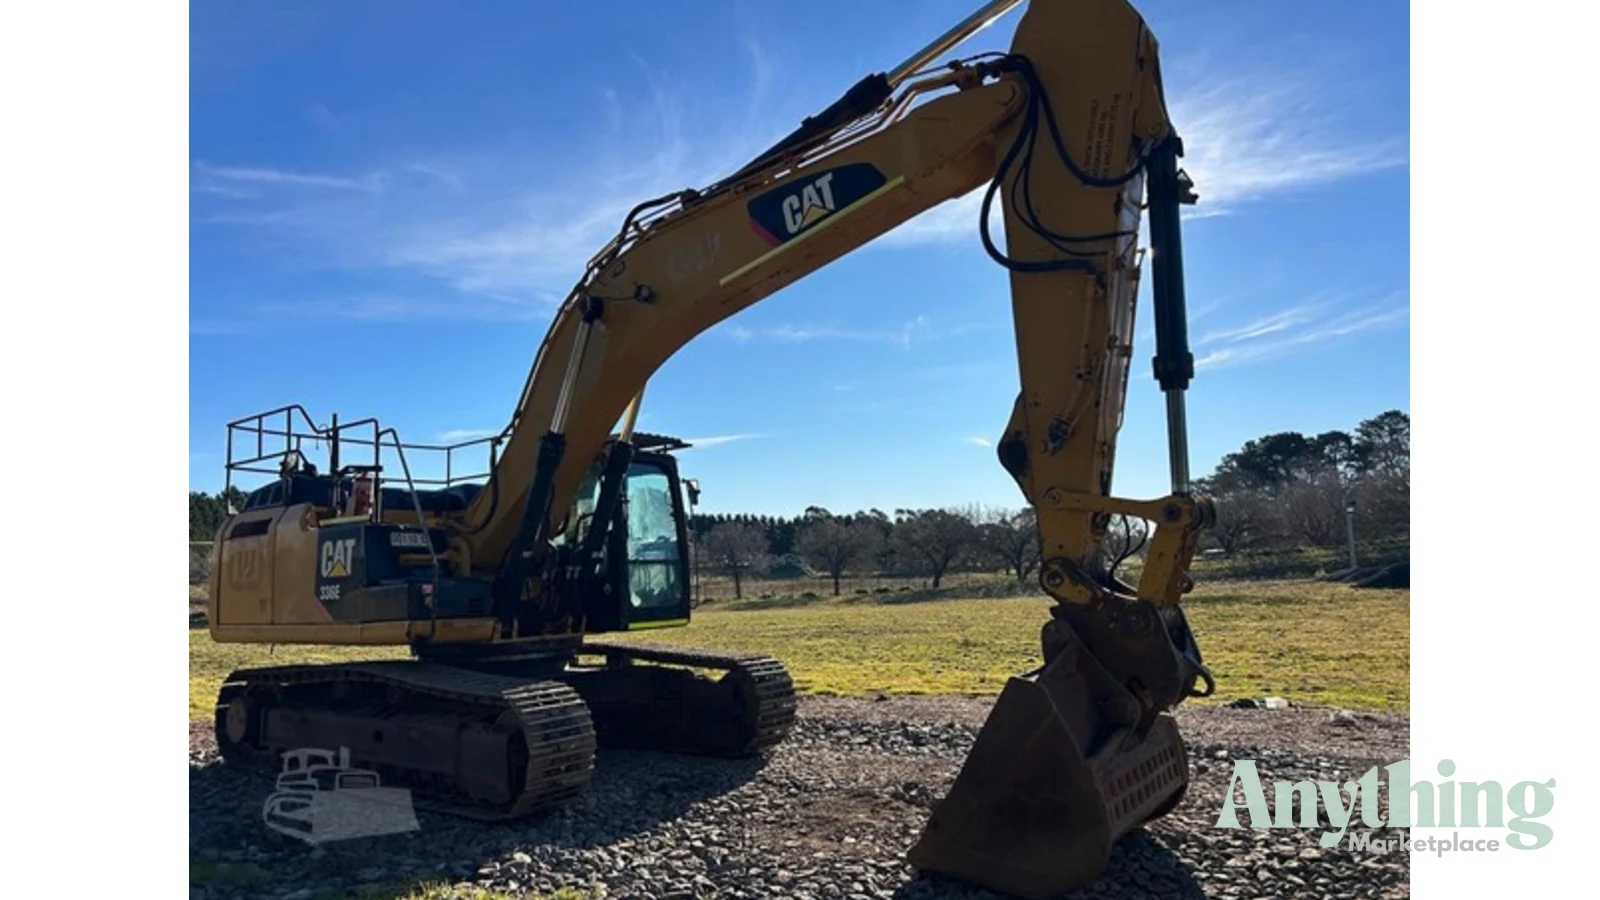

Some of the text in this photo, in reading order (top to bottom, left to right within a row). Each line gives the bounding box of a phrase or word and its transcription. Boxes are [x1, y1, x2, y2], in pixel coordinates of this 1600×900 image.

[782, 173, 834, 234] CAT
[321, 539, 356, 577] CAT
[320, 585, 341, 600] 336E
